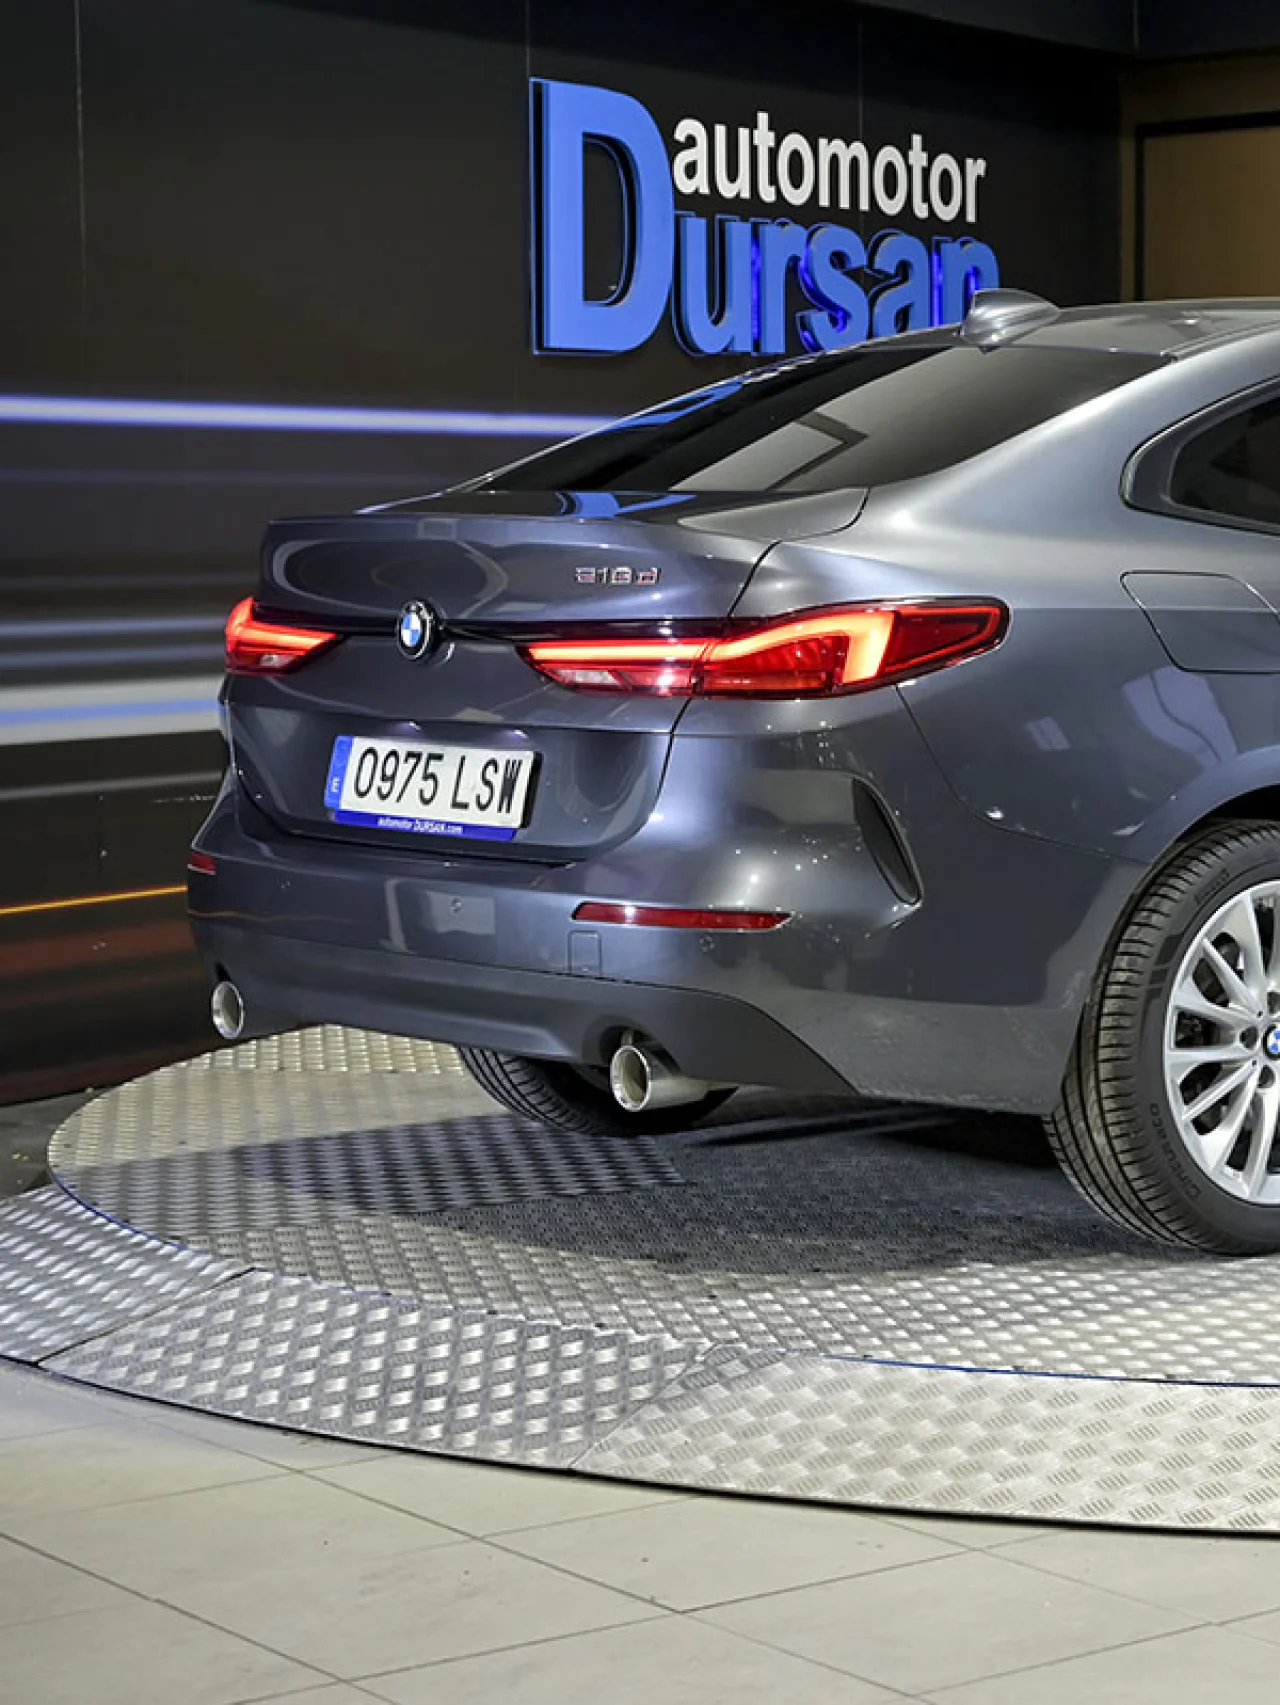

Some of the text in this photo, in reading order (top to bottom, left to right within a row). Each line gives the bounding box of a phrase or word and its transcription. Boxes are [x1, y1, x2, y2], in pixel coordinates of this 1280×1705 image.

[673, 111, 986, 223] automotor
[529, 77, 999, 356] Dursan
[330, 777, 340, 793] E
[354, 747, 523, 813] 0975 LSW
